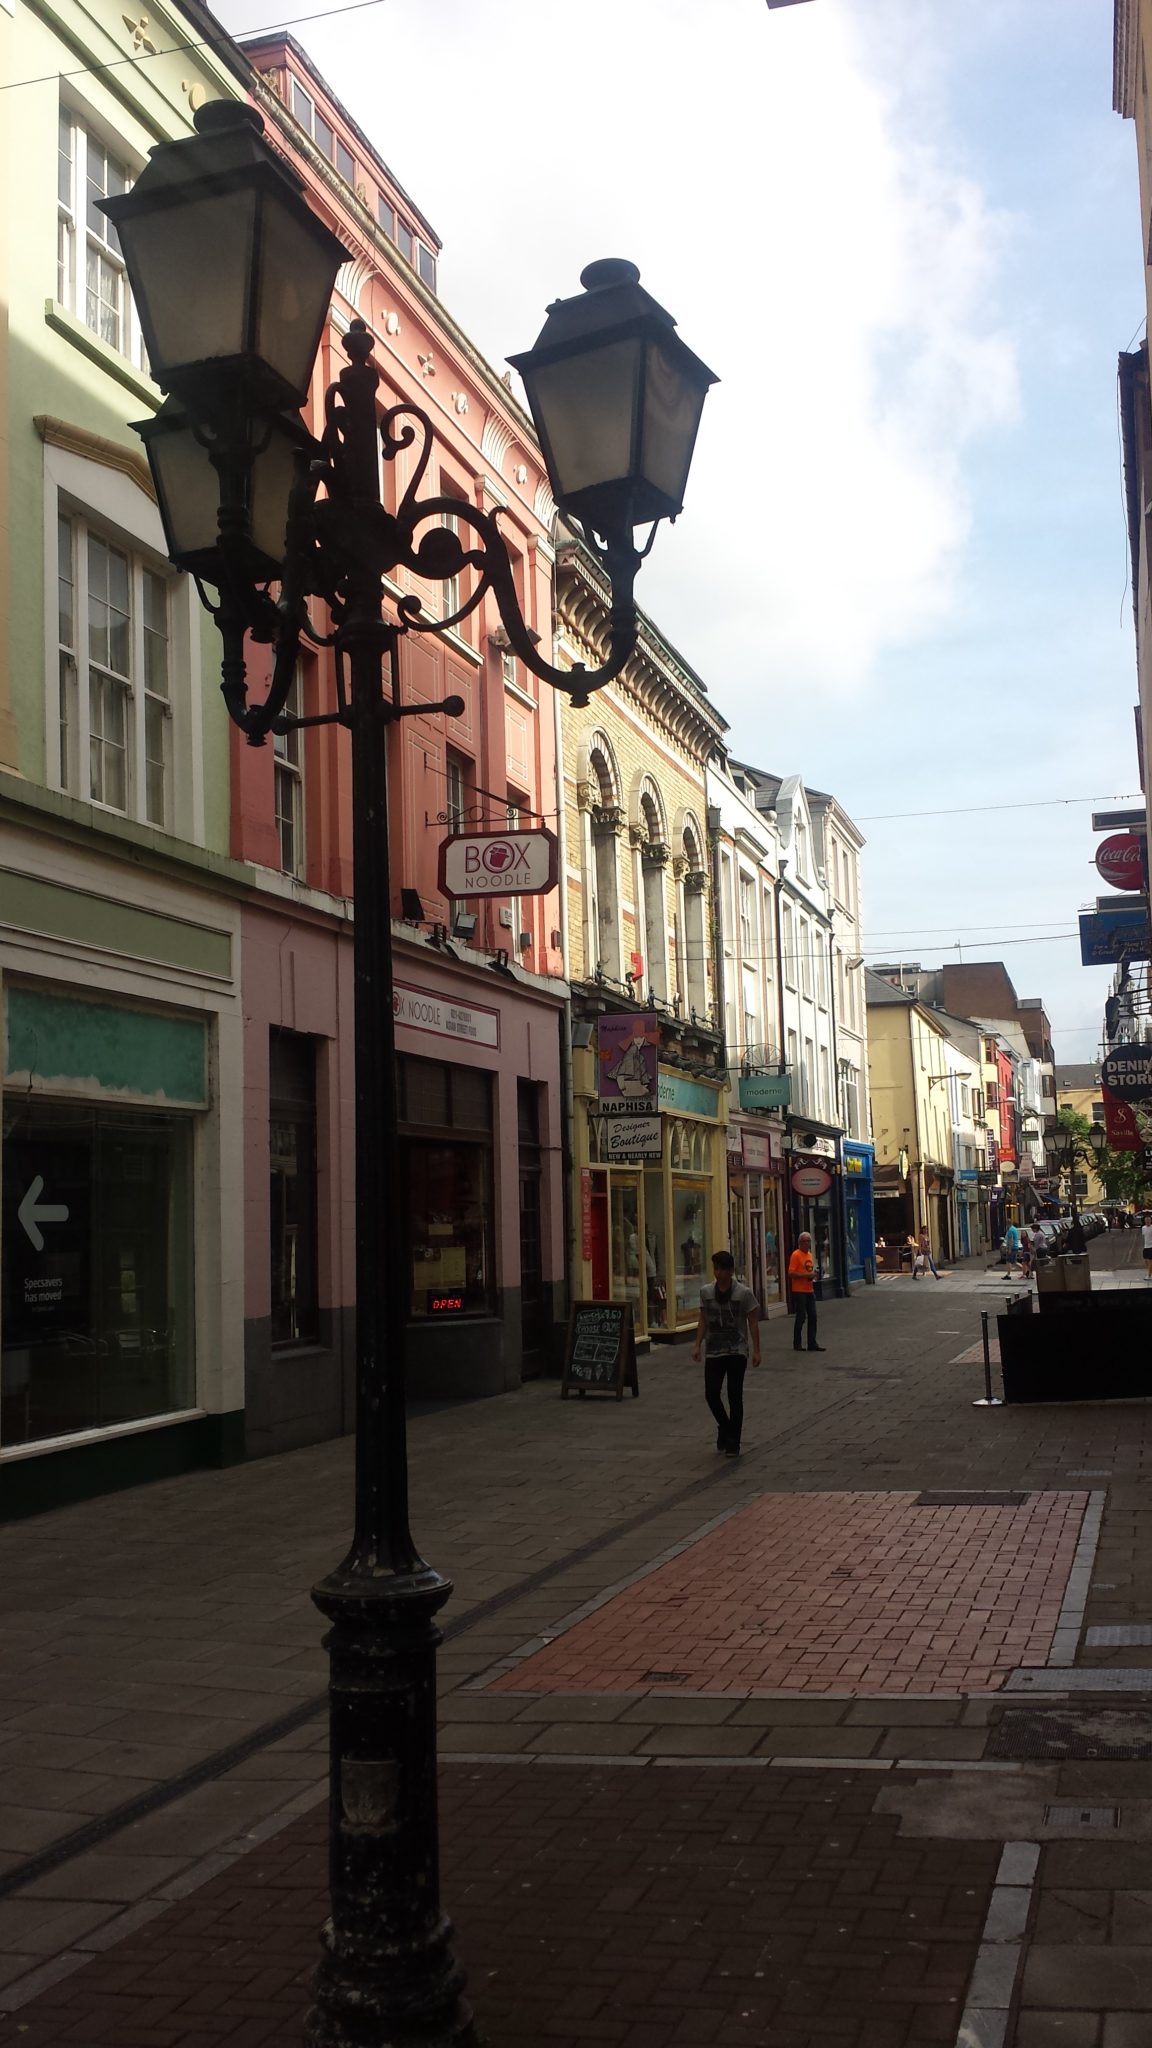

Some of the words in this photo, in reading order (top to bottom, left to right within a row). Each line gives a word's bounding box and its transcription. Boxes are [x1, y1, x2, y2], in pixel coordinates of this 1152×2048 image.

[465, 840, 531, 874] BOX
[465, 873, 531, 889] NOODLE
[393, 991, 405, 1016] OX
[408, 1001, 441, 1025] NOODLE
[658, 1083, 676, 1101] derne
[746, 1087, 783, 1096] moderne
[602, 1101, 653, 1112] NAPHISA
[613, 1121, 651, 1134] Designer
[610, 1131, 659, 1149] Boutique
[24, 1278, 62, 1290] Specsavers
[24, 1291, 38, 1302] has
[38, 1289, 62, 1302] moved
[433, 1299, 462, 1309] OPEN
